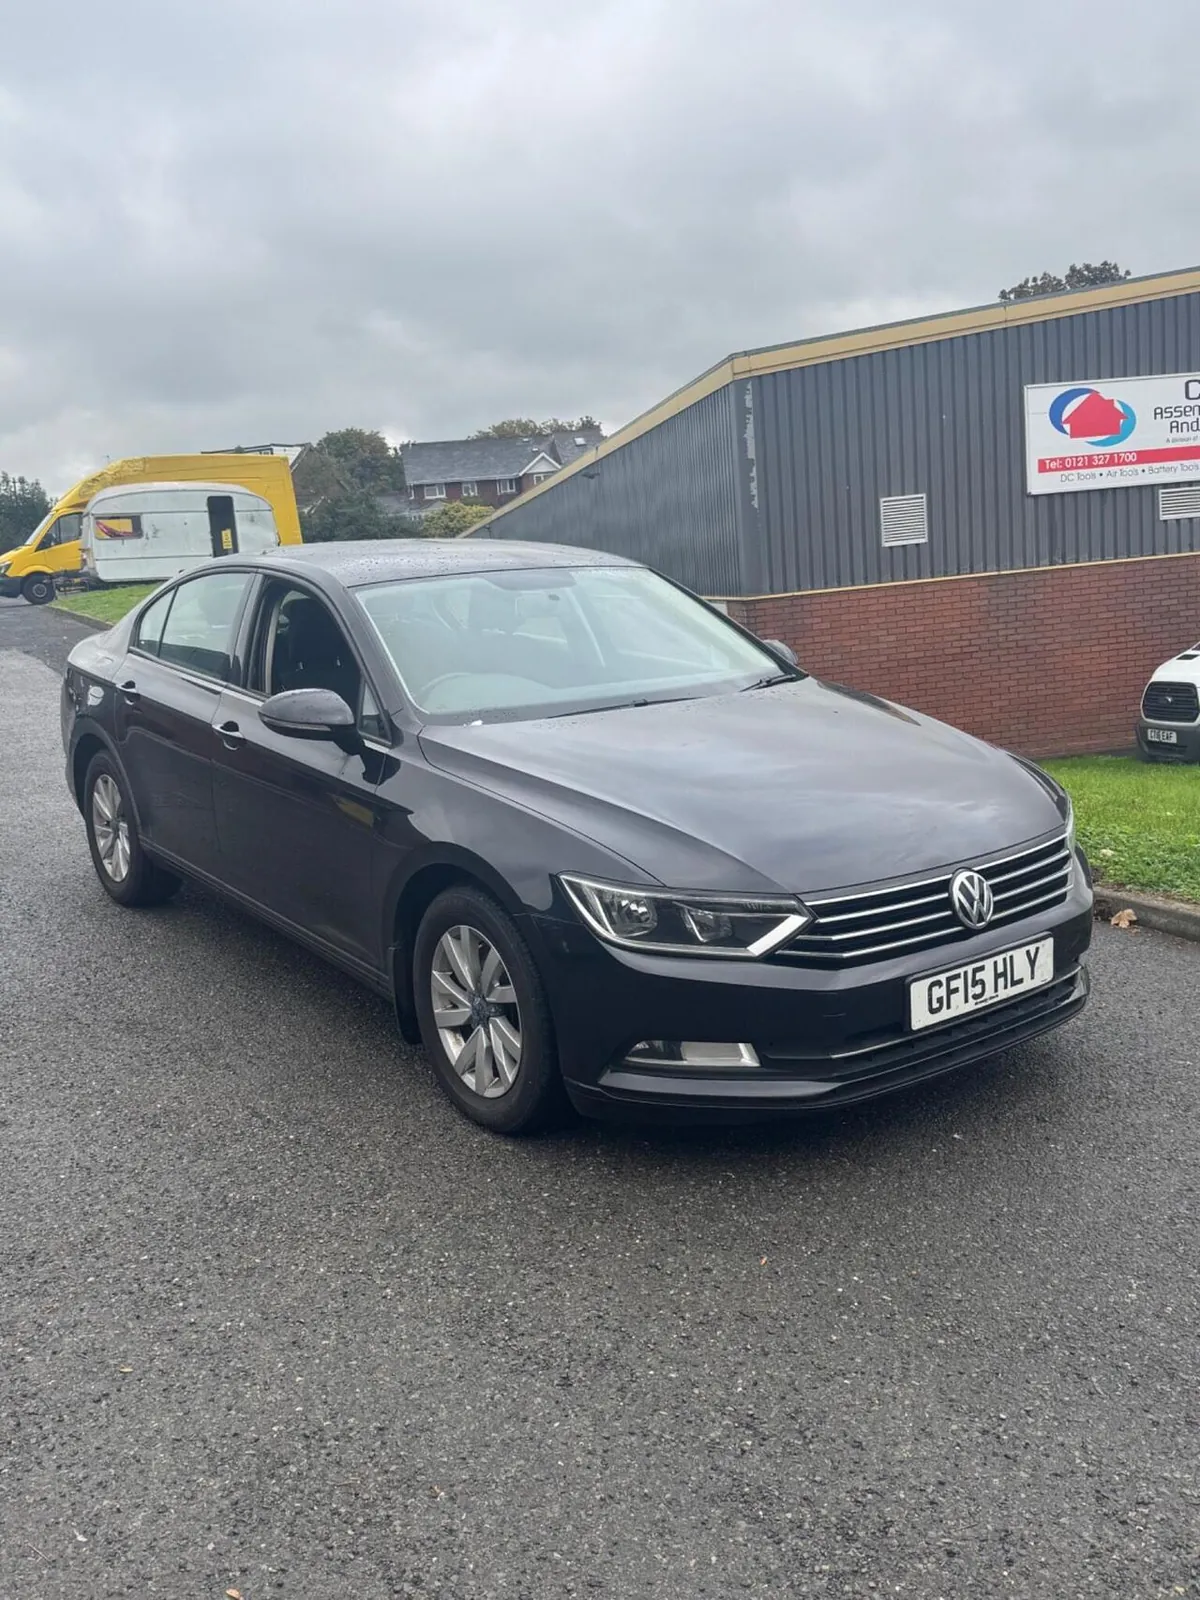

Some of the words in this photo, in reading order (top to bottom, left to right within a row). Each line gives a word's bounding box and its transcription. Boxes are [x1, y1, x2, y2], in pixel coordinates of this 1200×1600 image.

[1170, 417, 1200, 434] And
[1045, 459, 1063, 470] Tel:
[1065, 456, 1088, 468] 0121
[1092, 454, 1110, 466] 327
[1114, 452, 1137, 463] 1700
[1060, 473, 1075, 483] DC
[1077, 471, 1097, 481] Tools
[1106, 469, 1118, 478] Air
[1119, 468, 1139, 477] Tools
[1147, 465, 1178, 475] Battery
[1180, 462, 1199, 472] Tools
[927, 964, 986, 1015] GF15
[993, 946, 1041, 994] HLY
